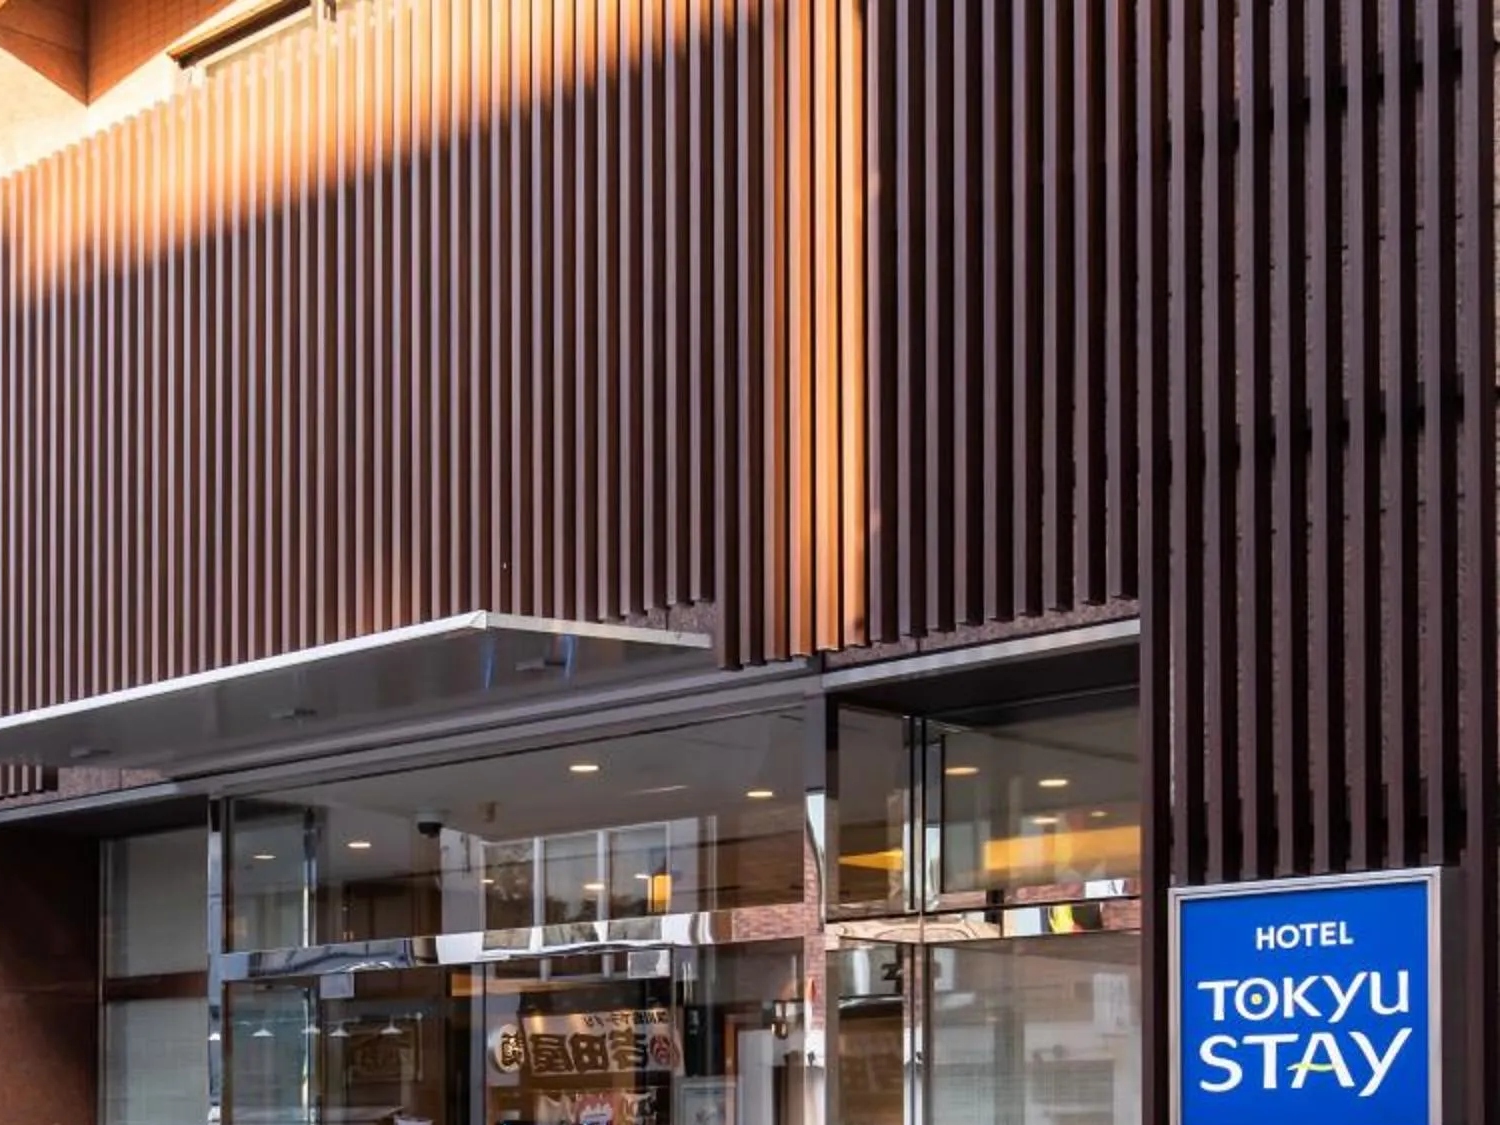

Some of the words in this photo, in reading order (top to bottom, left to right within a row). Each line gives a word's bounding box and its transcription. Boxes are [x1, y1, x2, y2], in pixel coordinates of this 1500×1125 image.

[1255, 920, 1354, 950] HOTEL
[1197, 970, 1410, 1024] TOKYU
[1198, 1027, 1413, 1098] STAY
